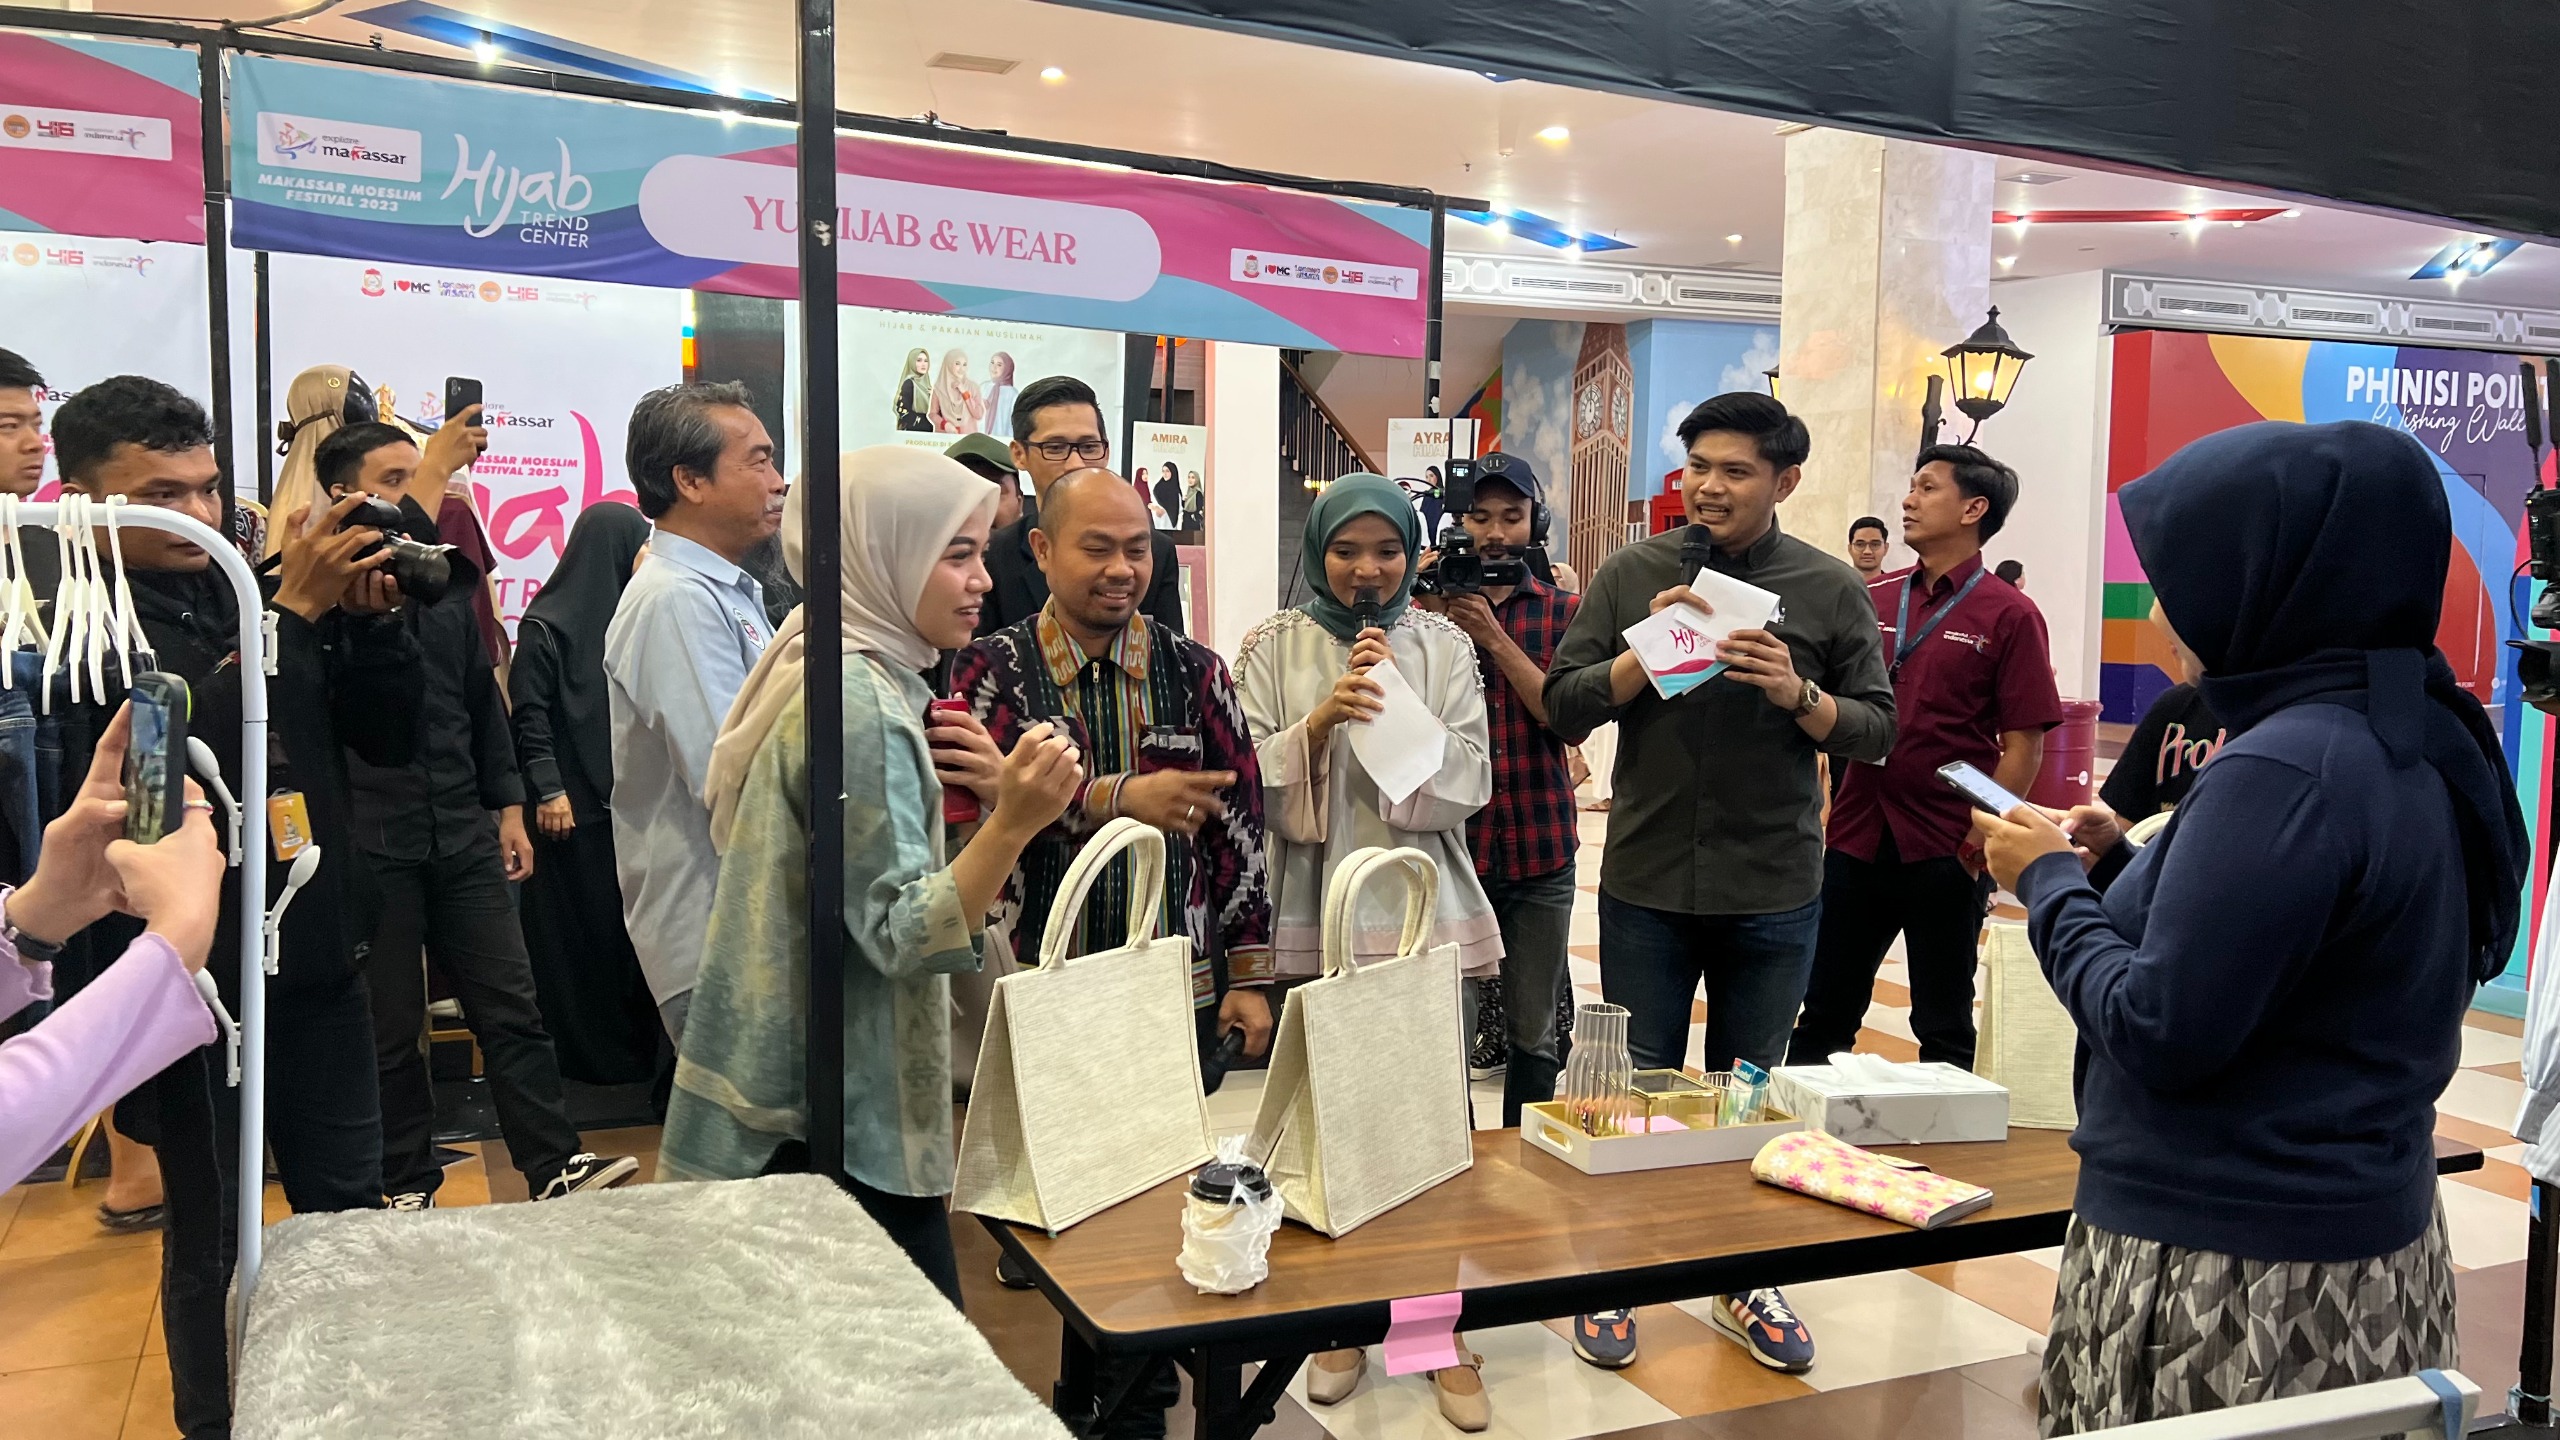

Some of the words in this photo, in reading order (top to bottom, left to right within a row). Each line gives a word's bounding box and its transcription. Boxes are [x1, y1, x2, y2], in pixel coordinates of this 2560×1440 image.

[322, 134, 360, 145] explore
[322, 144, 408, 166] makassar
[258, 173, 347, 195] MAKASSAR
[351, 184, 422, 202] MOESLIM
[440, 133, 592, 239] Hijab
[286, 189, 354, 208] FESTIVAL
[358, 197, 399, 212] 2023
[519, 210, 589, 232] TREND
[519, 227, 589, 249] CENTER
[835, 205, 922, 249] IJAB
[929, 218, 959, 253] &
[966, 222, 1078, 267] WEAR
[410, 282, 431, 293] MC
[879, 321, 913, 332] HIJAB
[931, 325, 980, 336] PAKAIAN
[986, 331, 1043, 341] MUSLIMAH
[2346, 366, 2460, 407] PHINISI
[481, 411, 555, 429] akassar
[2467, 403, 2527, 444] Wall
[1151, 433, 1188, 445] AMIRA
[520, 457, 579, 468] MOESLIM
[528, 467, 560, 477] 2023
